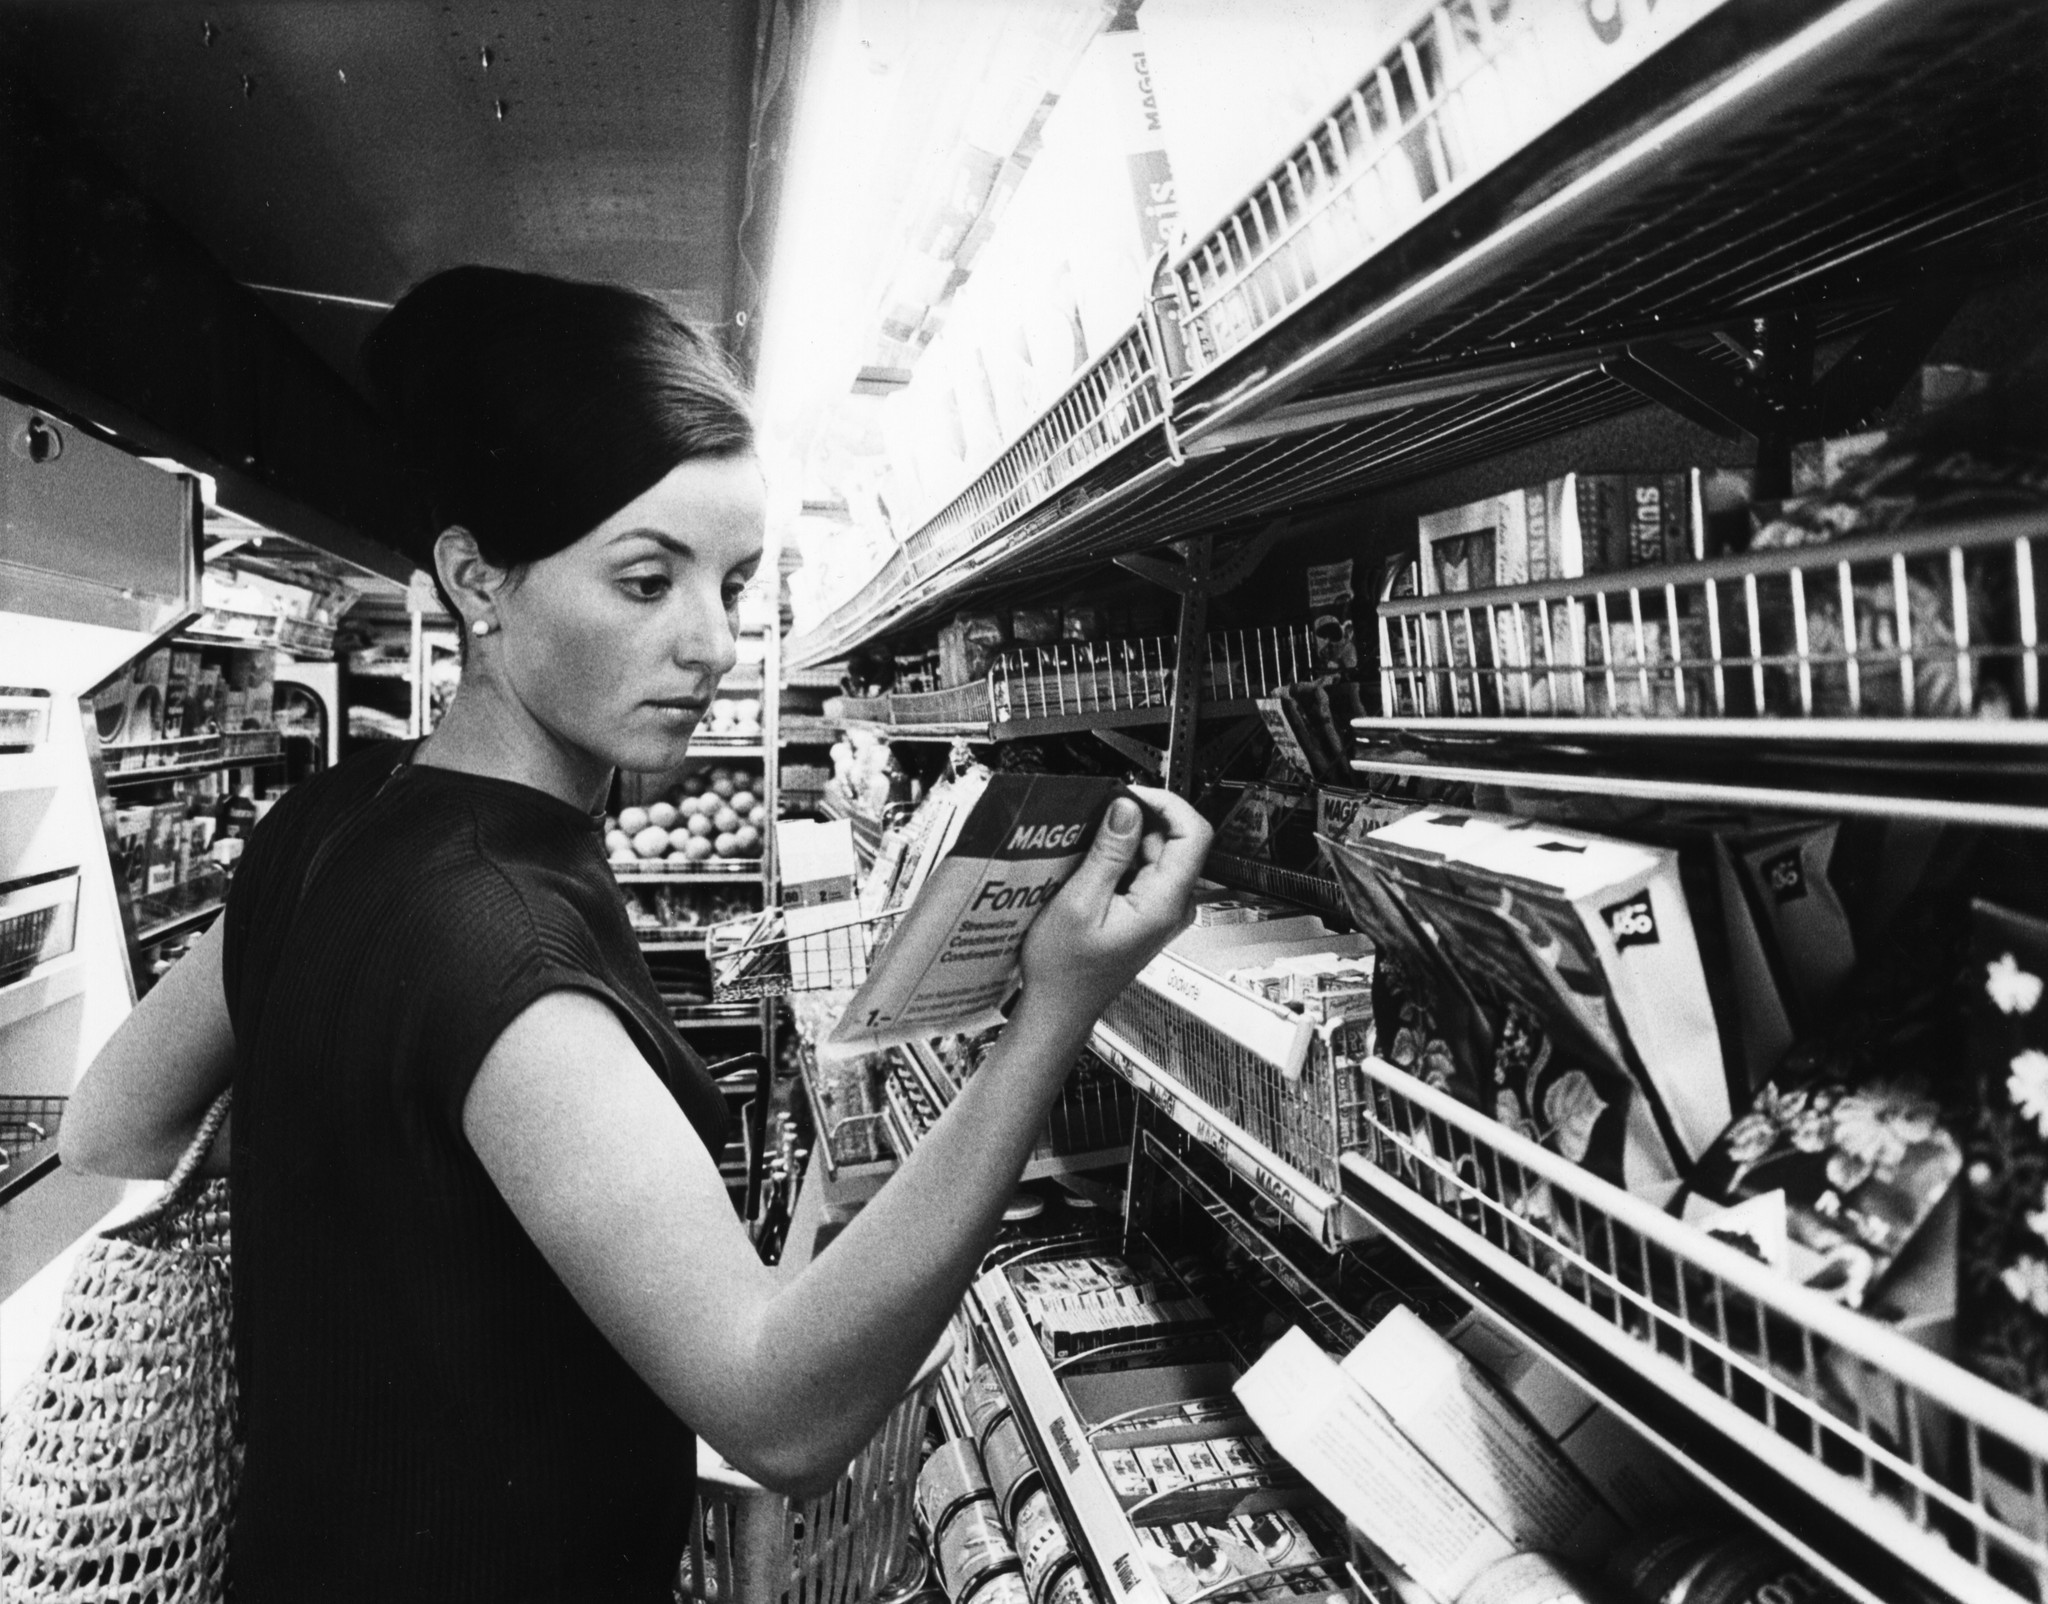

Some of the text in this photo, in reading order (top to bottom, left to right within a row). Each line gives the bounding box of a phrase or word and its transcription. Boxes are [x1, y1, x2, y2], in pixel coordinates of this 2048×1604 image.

[1132, 52, 1161, 132] MAGGI
[1007, 822, 1087, 850] MAGGI
[1255, 1166, 1297, 1215] MAGGI
